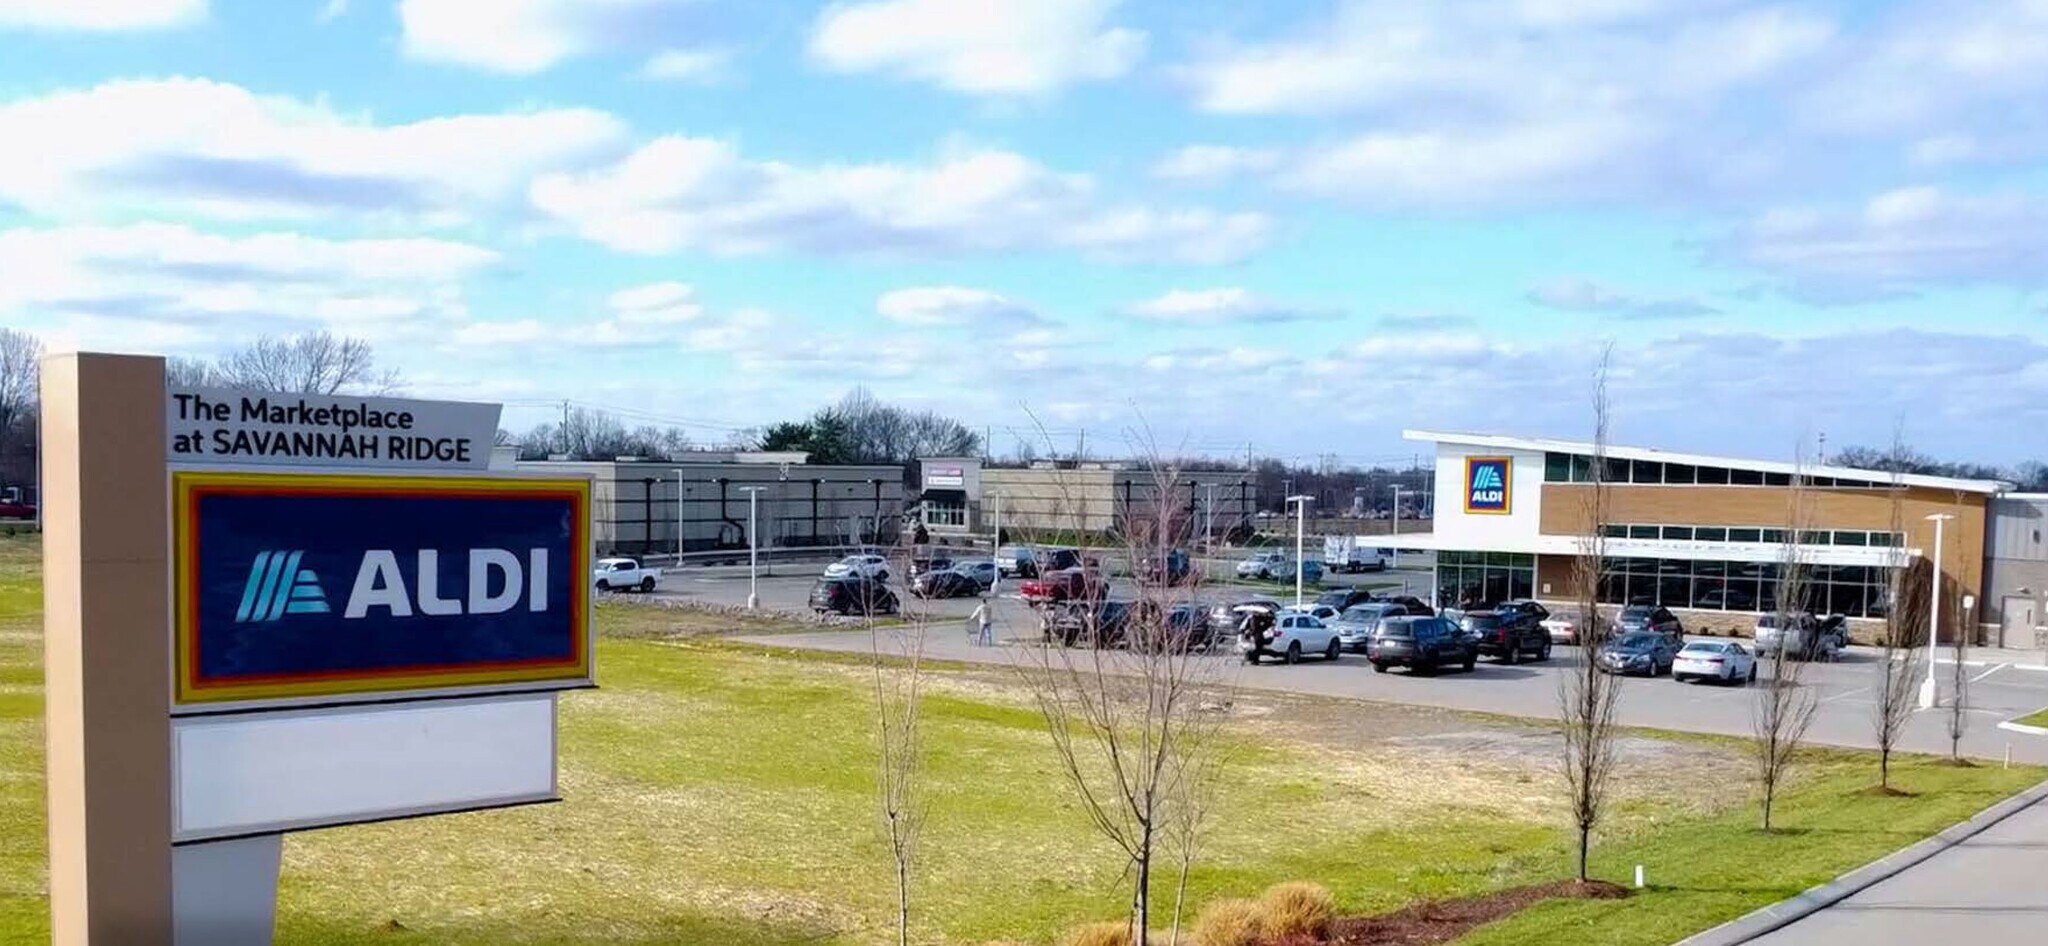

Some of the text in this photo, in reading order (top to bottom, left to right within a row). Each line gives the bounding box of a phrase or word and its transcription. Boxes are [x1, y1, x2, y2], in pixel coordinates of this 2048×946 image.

[173, 394, 414, 432] The Marketplace
[173, 429, 471, 462] at SAVANNAH RIDGE
[1472, 490, 1503, 502] ALDI
[344, 548, 549, 619] ALDI
